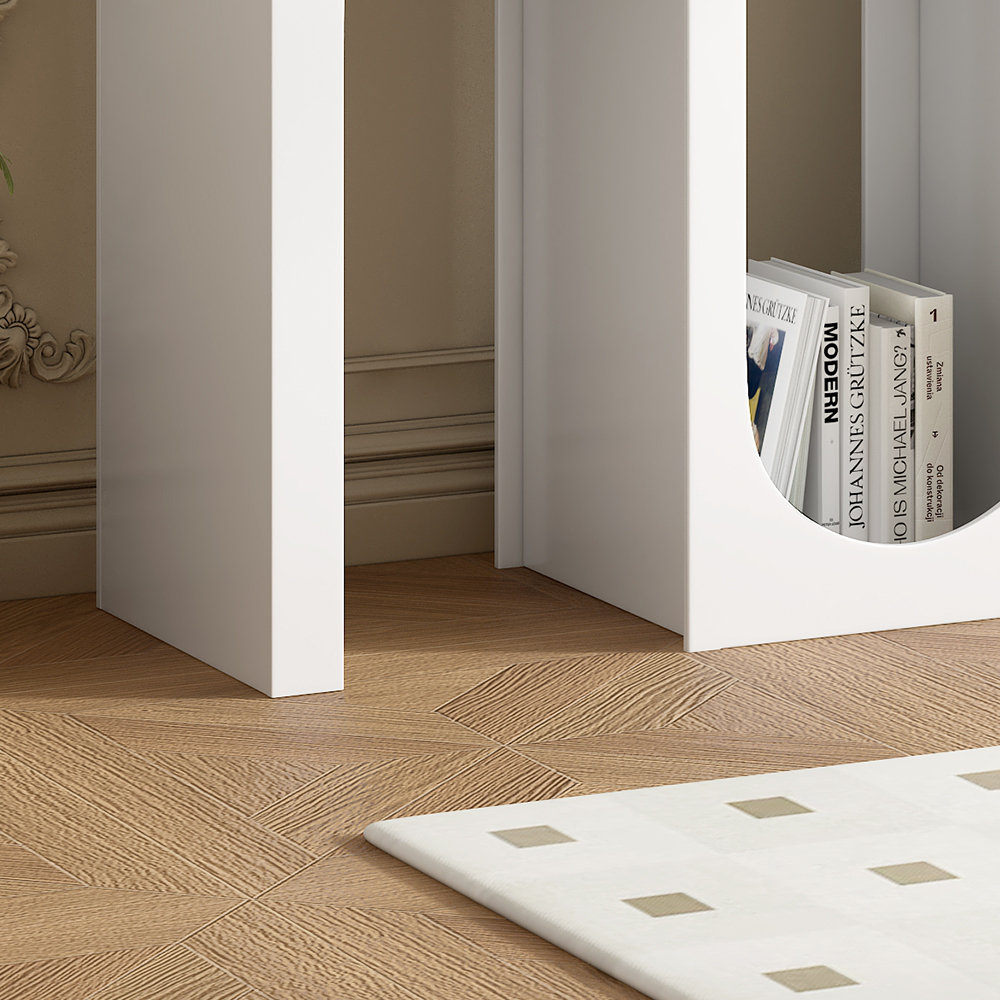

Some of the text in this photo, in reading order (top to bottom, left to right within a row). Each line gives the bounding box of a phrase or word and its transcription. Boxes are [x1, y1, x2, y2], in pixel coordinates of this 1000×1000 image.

[929, 308, 938, 322] 1
[823, 322, 839, 424] MODERN
[893, 345, 908, 406] JANG?
[926, 355, 934, 401] ustawienia
[936, 361, 944, 392] Zmiana
[846, 304, 865, 529] JOHANNES GRÜTZKE
[892, 408, 907, 496] MICHAEL
[893, 499, 908, 517] IS
[925, 462, 935, 522] do konstrukcji
[935, 464, 944, 518] Od dekoracji
